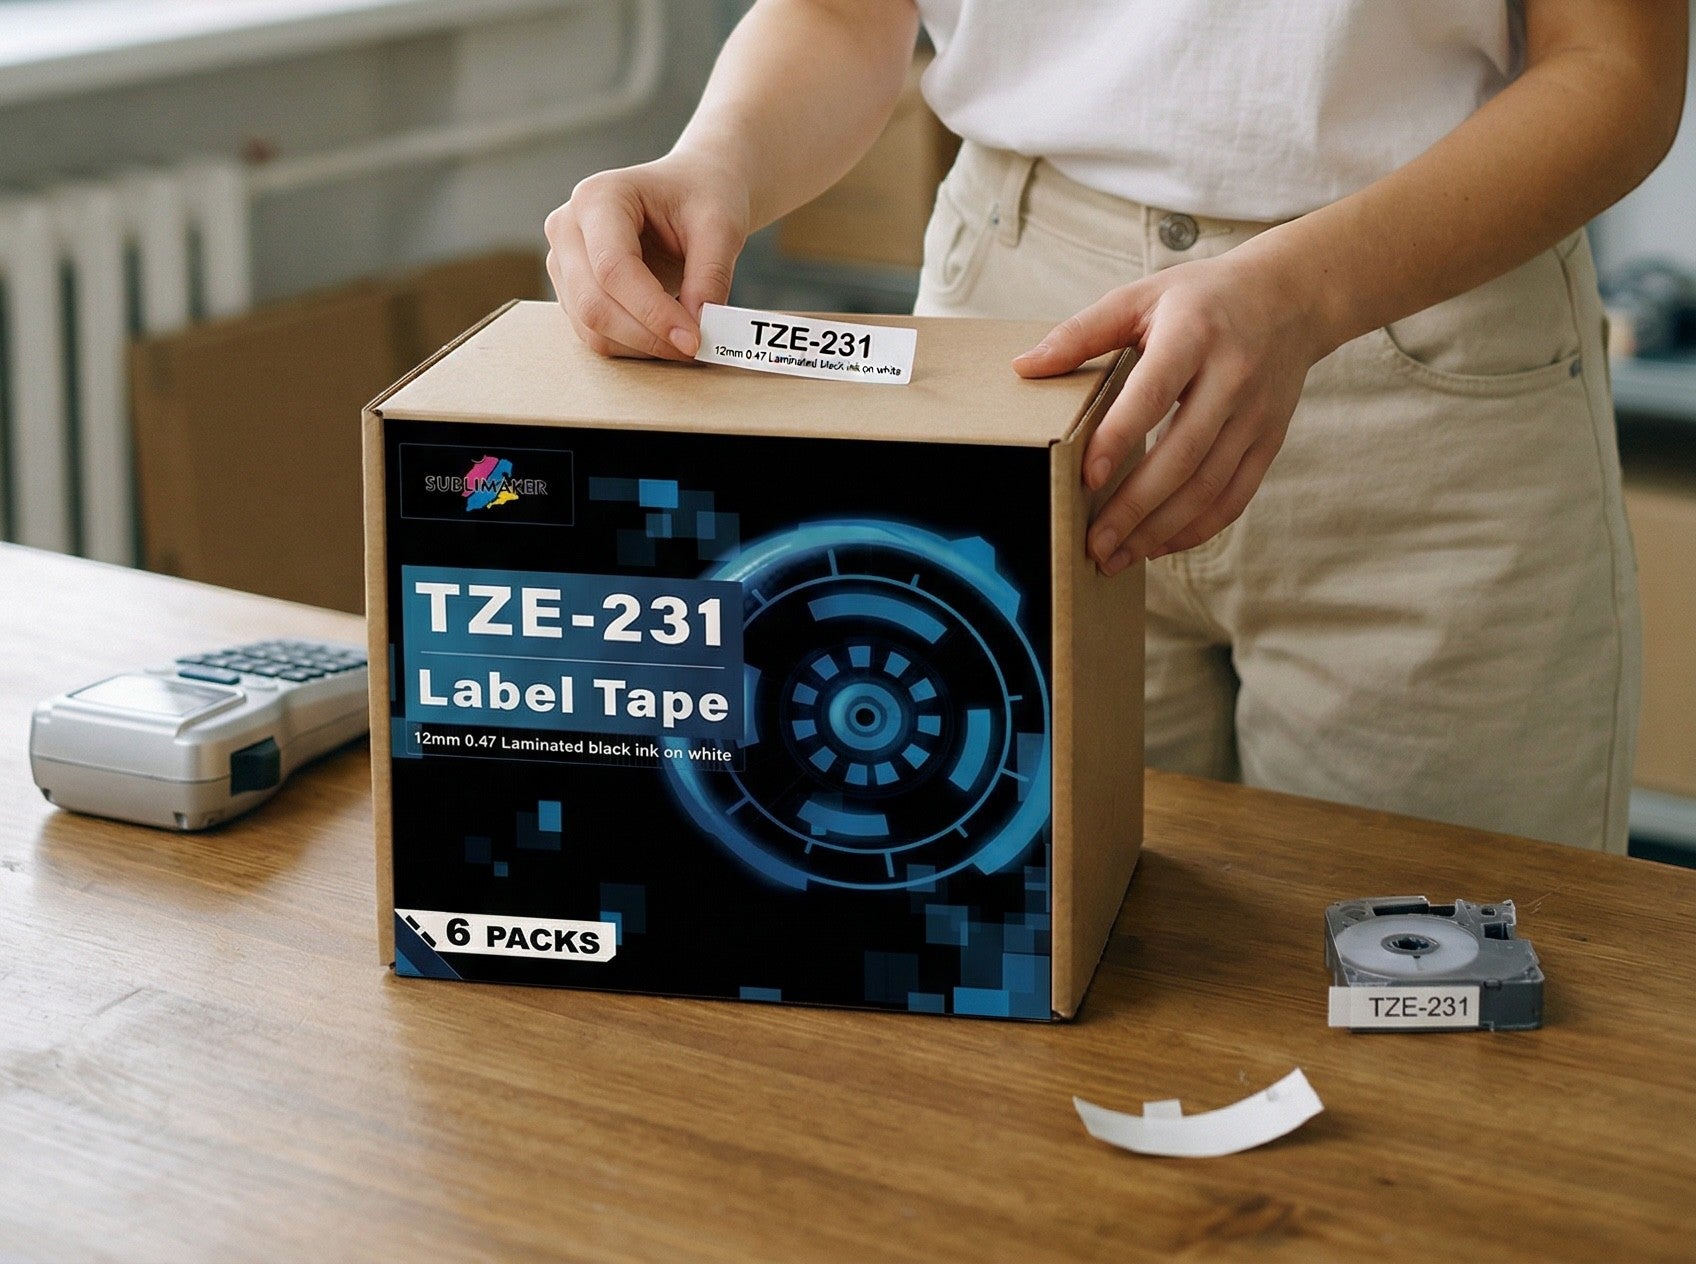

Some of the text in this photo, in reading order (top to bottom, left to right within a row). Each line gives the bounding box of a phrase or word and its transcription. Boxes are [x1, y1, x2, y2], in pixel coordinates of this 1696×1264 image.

[750, 320, 871, 359] TZE-231
[715, 345, 743, 358] 12mm
[862, 365, 874, 374] on
[425, 475, 548, 495] SUBLIMAKER
[415, 582, 722, 647] TZE-231
[419, 669, 729, 728] Label Tape
[414, 731, 732, 762] 12mm 0.47 Laminated black ink on white
[446, 918, 600, 954] 6 PACKS
[1368, 996, 1468, 1018] TZE-231
